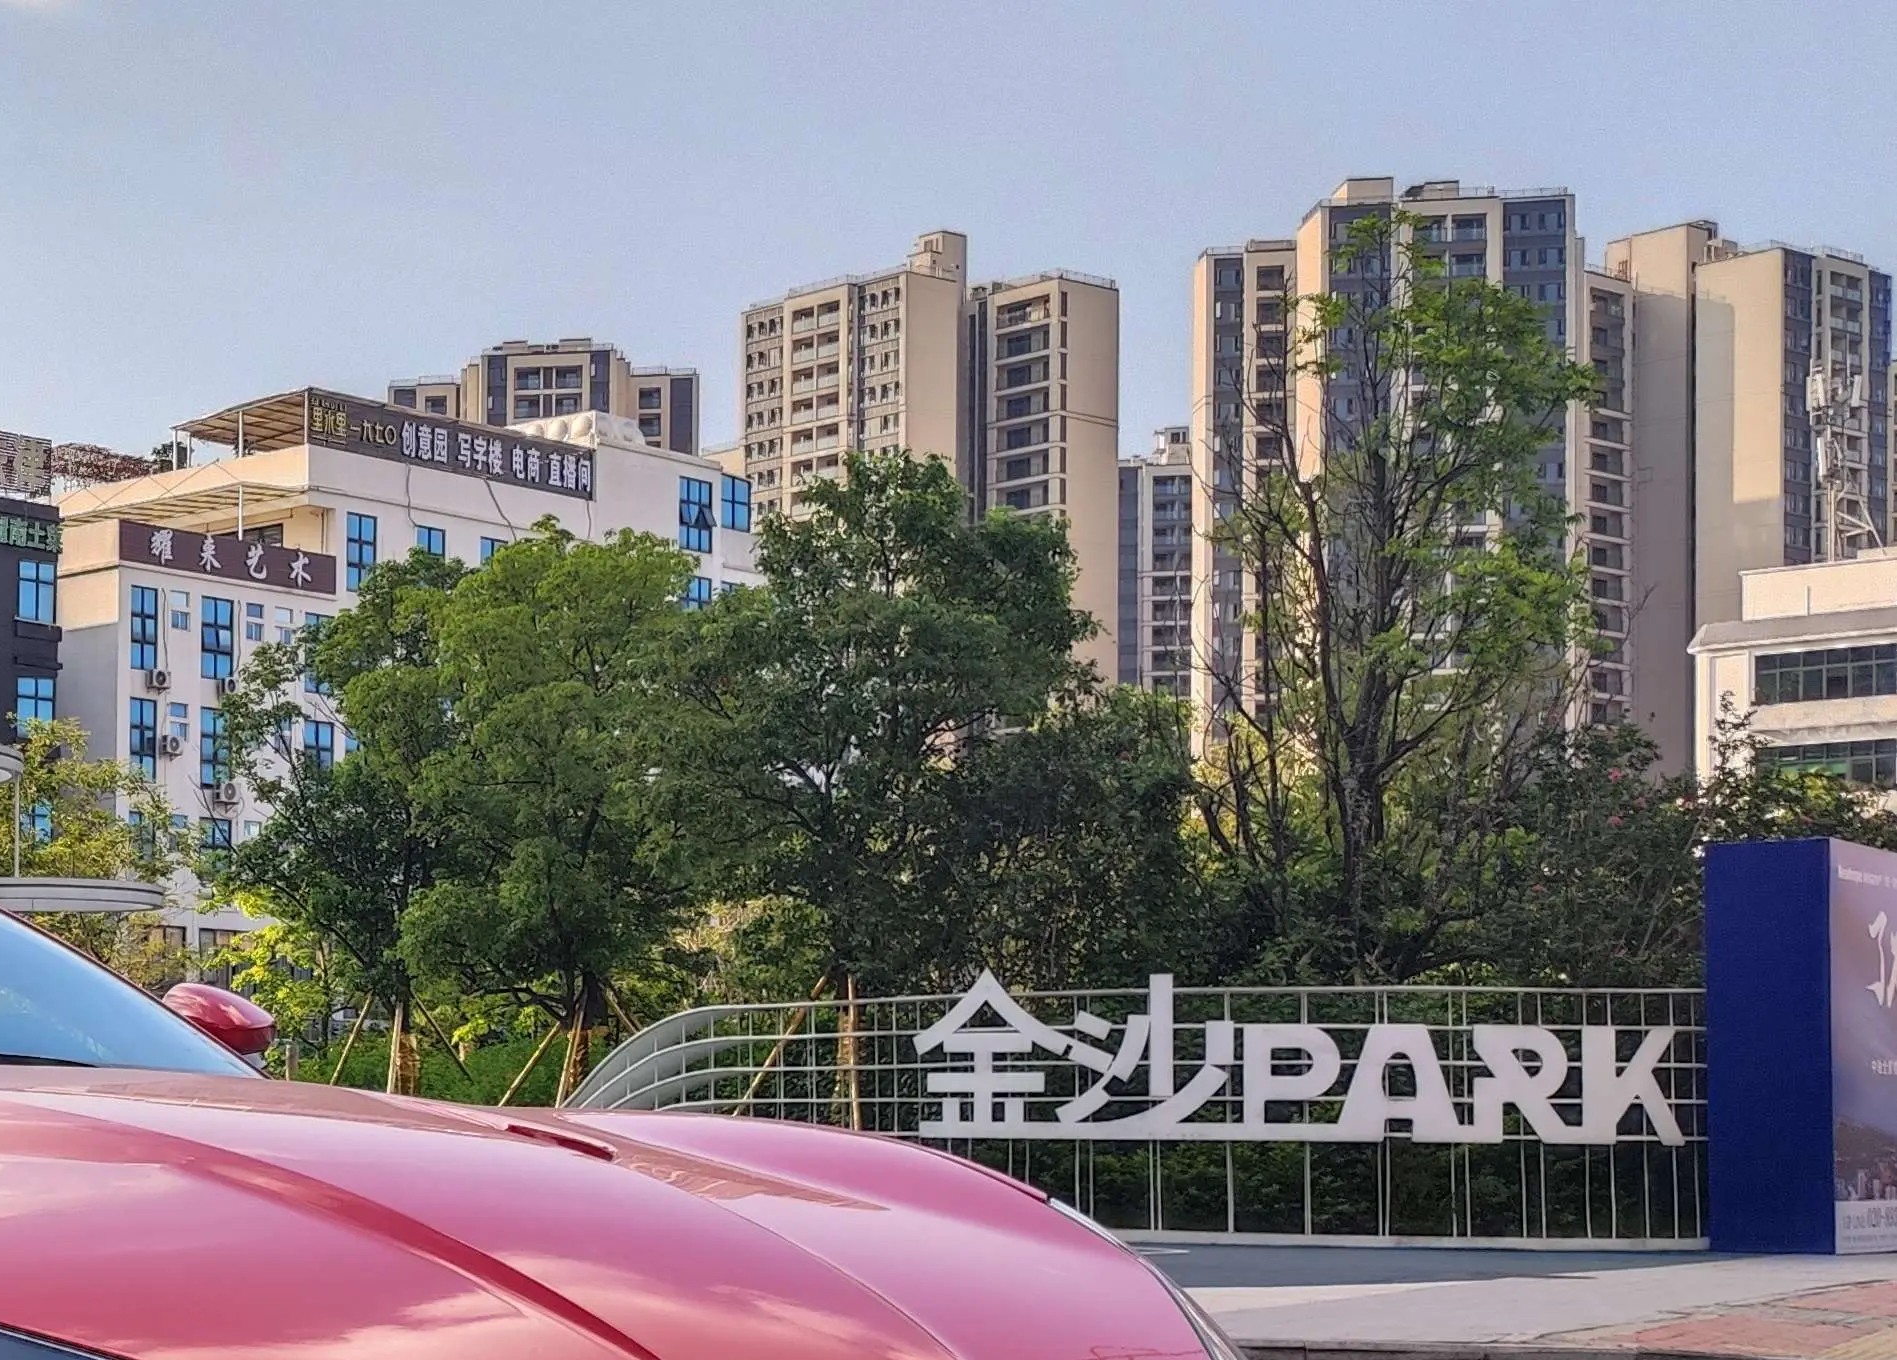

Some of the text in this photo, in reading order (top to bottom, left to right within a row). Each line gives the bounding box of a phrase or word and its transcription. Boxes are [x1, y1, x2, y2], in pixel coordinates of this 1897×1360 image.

[400, 420, 448, 464] 创意园
[457, 432, 504, 475] 写字楼
[512, 443, 540, 483] 电商
